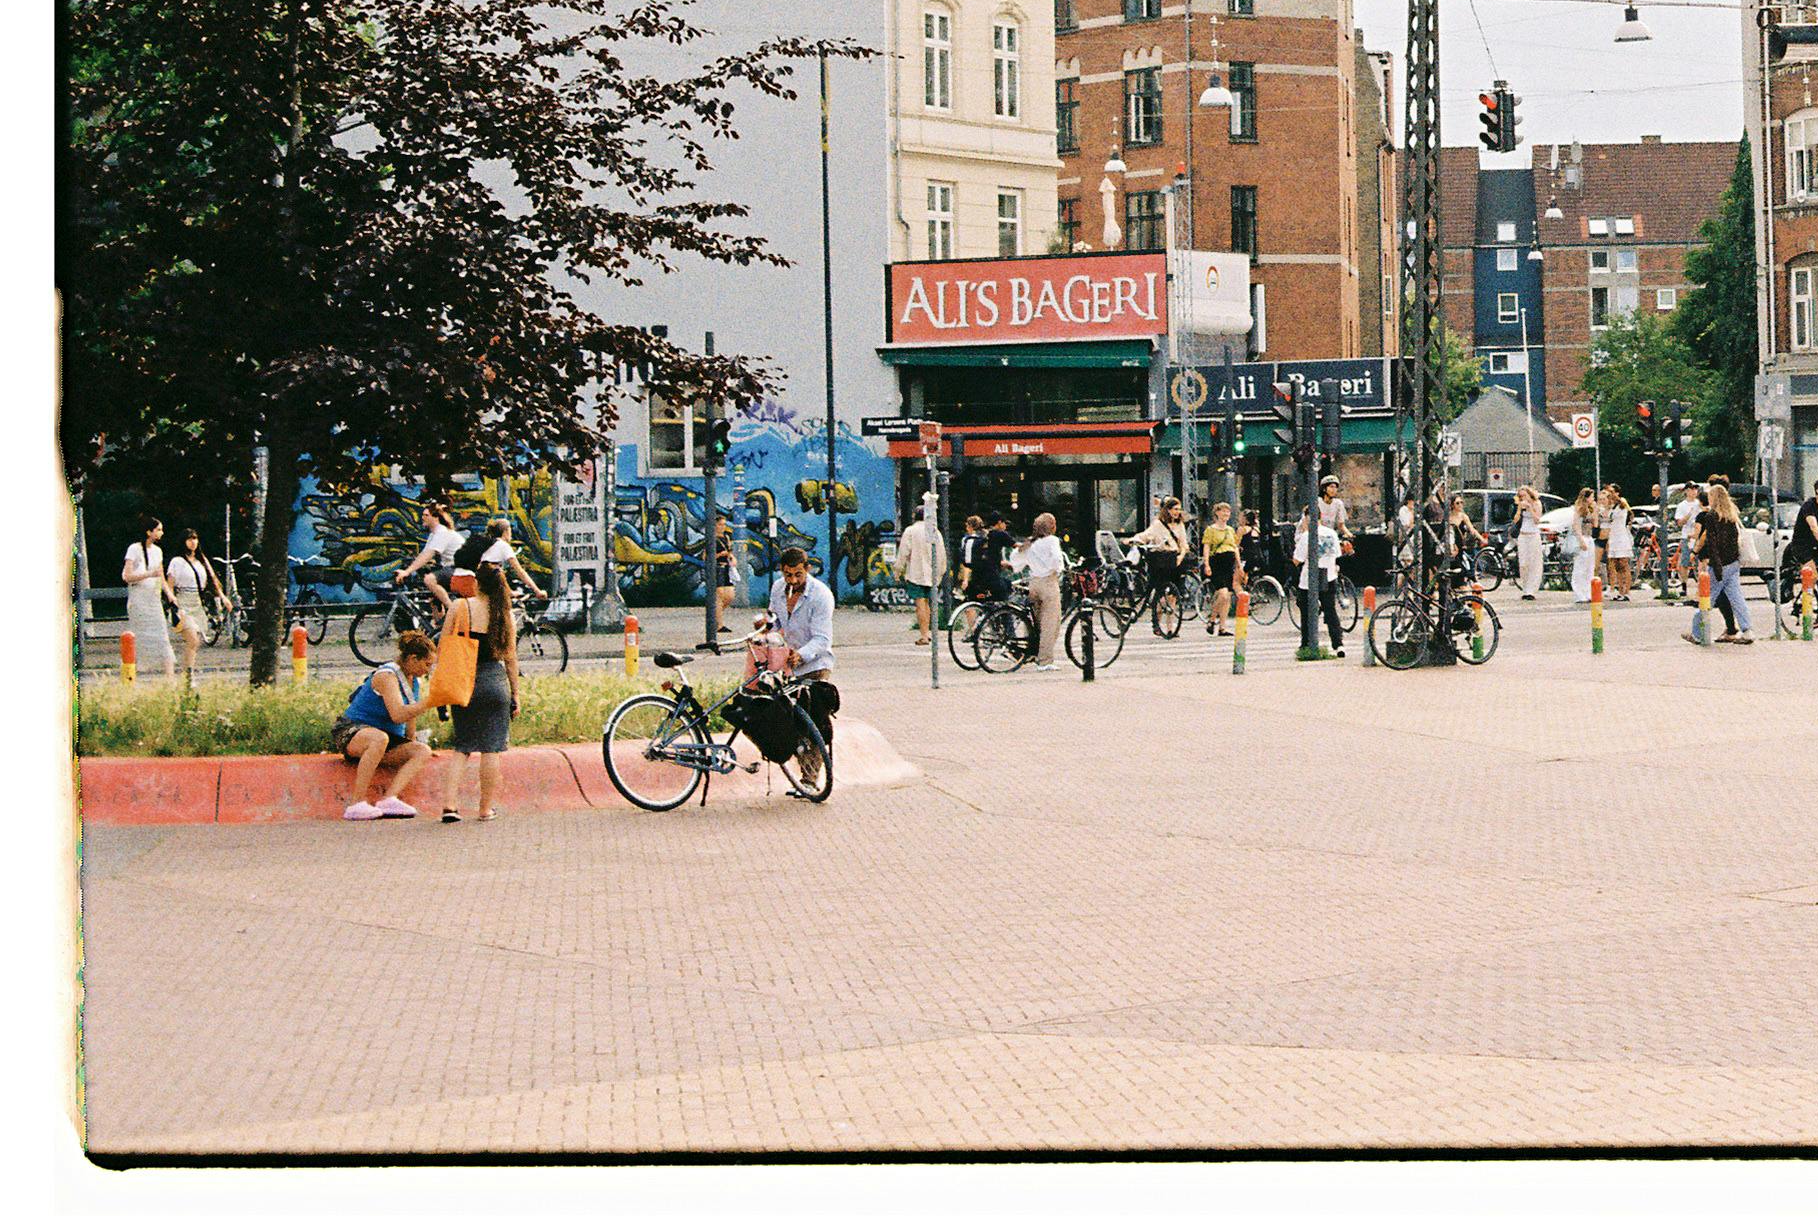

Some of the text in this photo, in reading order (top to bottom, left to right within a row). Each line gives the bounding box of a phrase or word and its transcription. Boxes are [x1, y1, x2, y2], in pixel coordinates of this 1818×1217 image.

[1009, 272, 1159, 326] BAGERI
[1218, 370, 1374, 400] Ali Baeri
[1577, 423, 1590, 433] 40
[994, 442, 1044, 455] Ali Bageri
